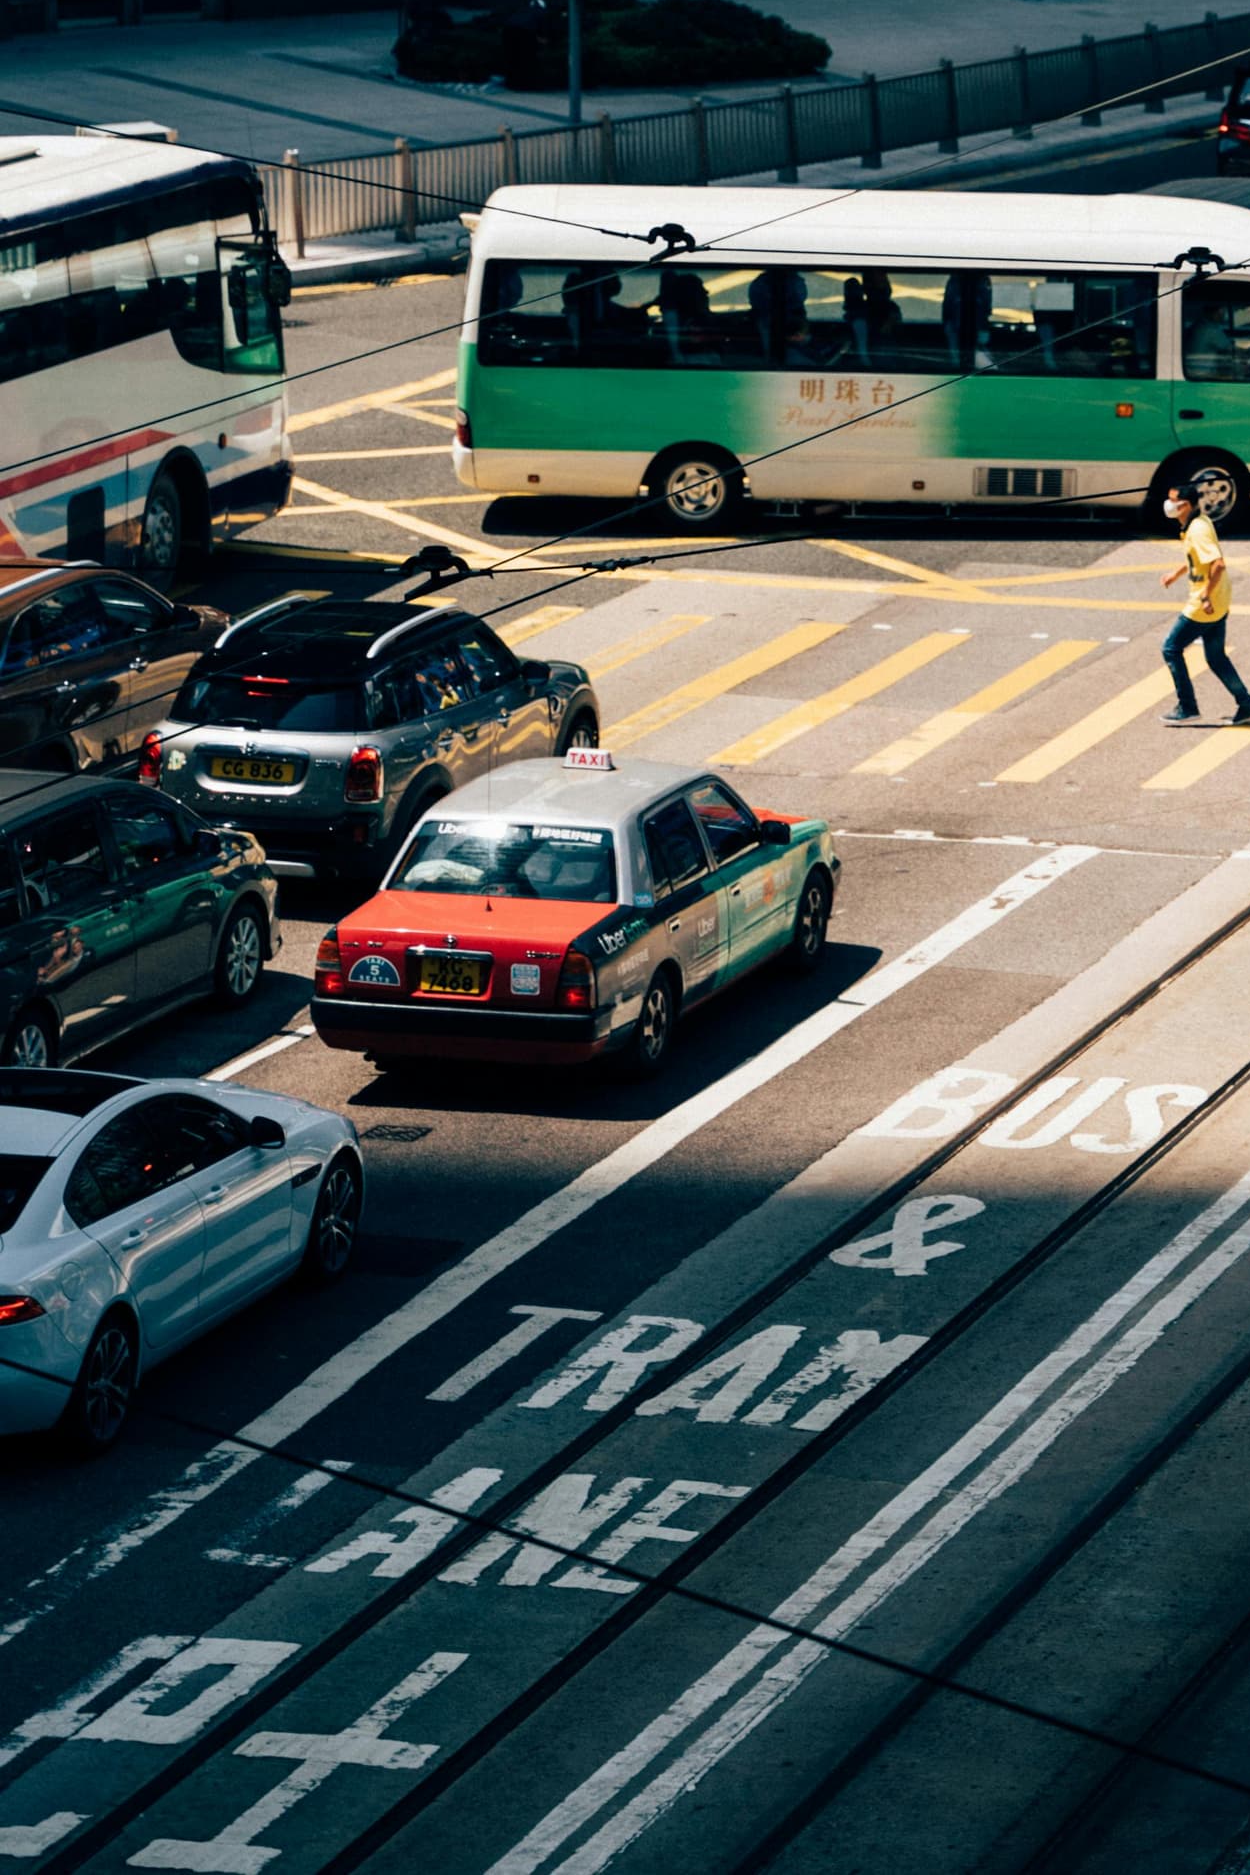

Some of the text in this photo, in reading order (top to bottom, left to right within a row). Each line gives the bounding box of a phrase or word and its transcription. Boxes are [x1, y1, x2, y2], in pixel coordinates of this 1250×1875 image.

[800, 378, 895, 405] 明珠台
[221, 759, 284, 781] CG 836
[569, 751, 607, 766] TAXI
[369, 965, 380, 976] 5
[427, 974, 473, 992] 7468
[857, 1066, 1209, 1154] BUS
[829, 1194, 986, 1277] &
[425, 1304, 930, 1431] TRAM
